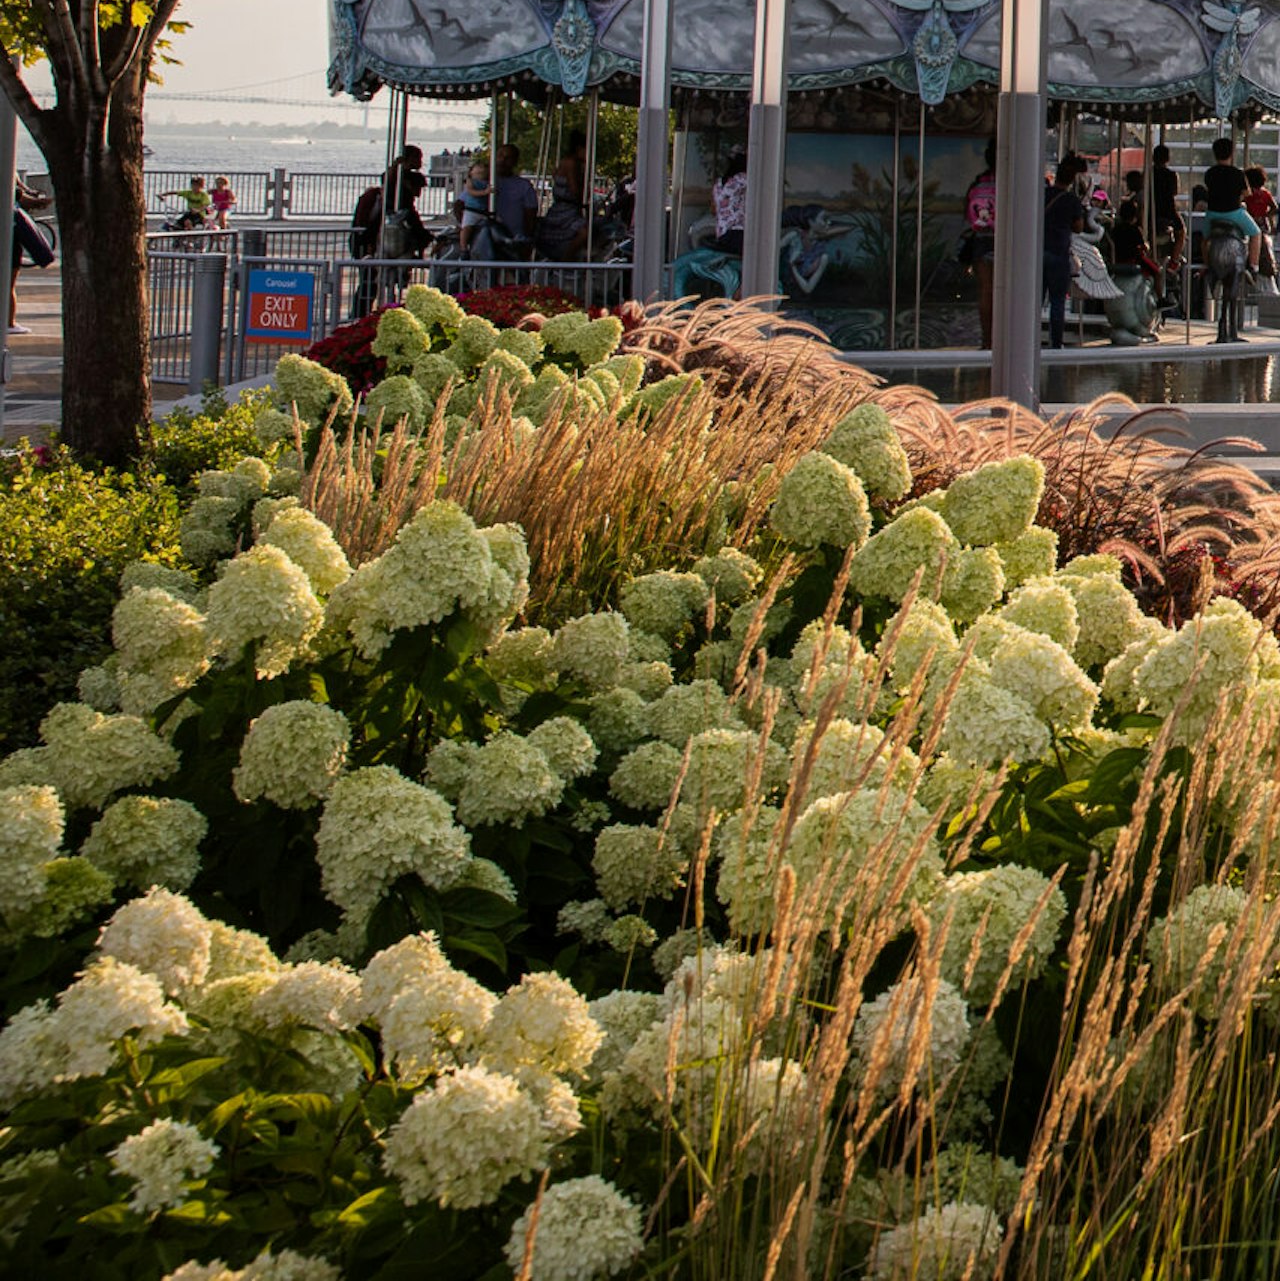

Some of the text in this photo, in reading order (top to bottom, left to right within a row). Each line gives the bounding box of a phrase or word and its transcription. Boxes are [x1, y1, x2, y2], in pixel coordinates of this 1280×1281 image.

[265, 278, 298, 288] Carousel
[265, 296, 294, 311] EXIT
[260, 311, 298, 328] ONLY
